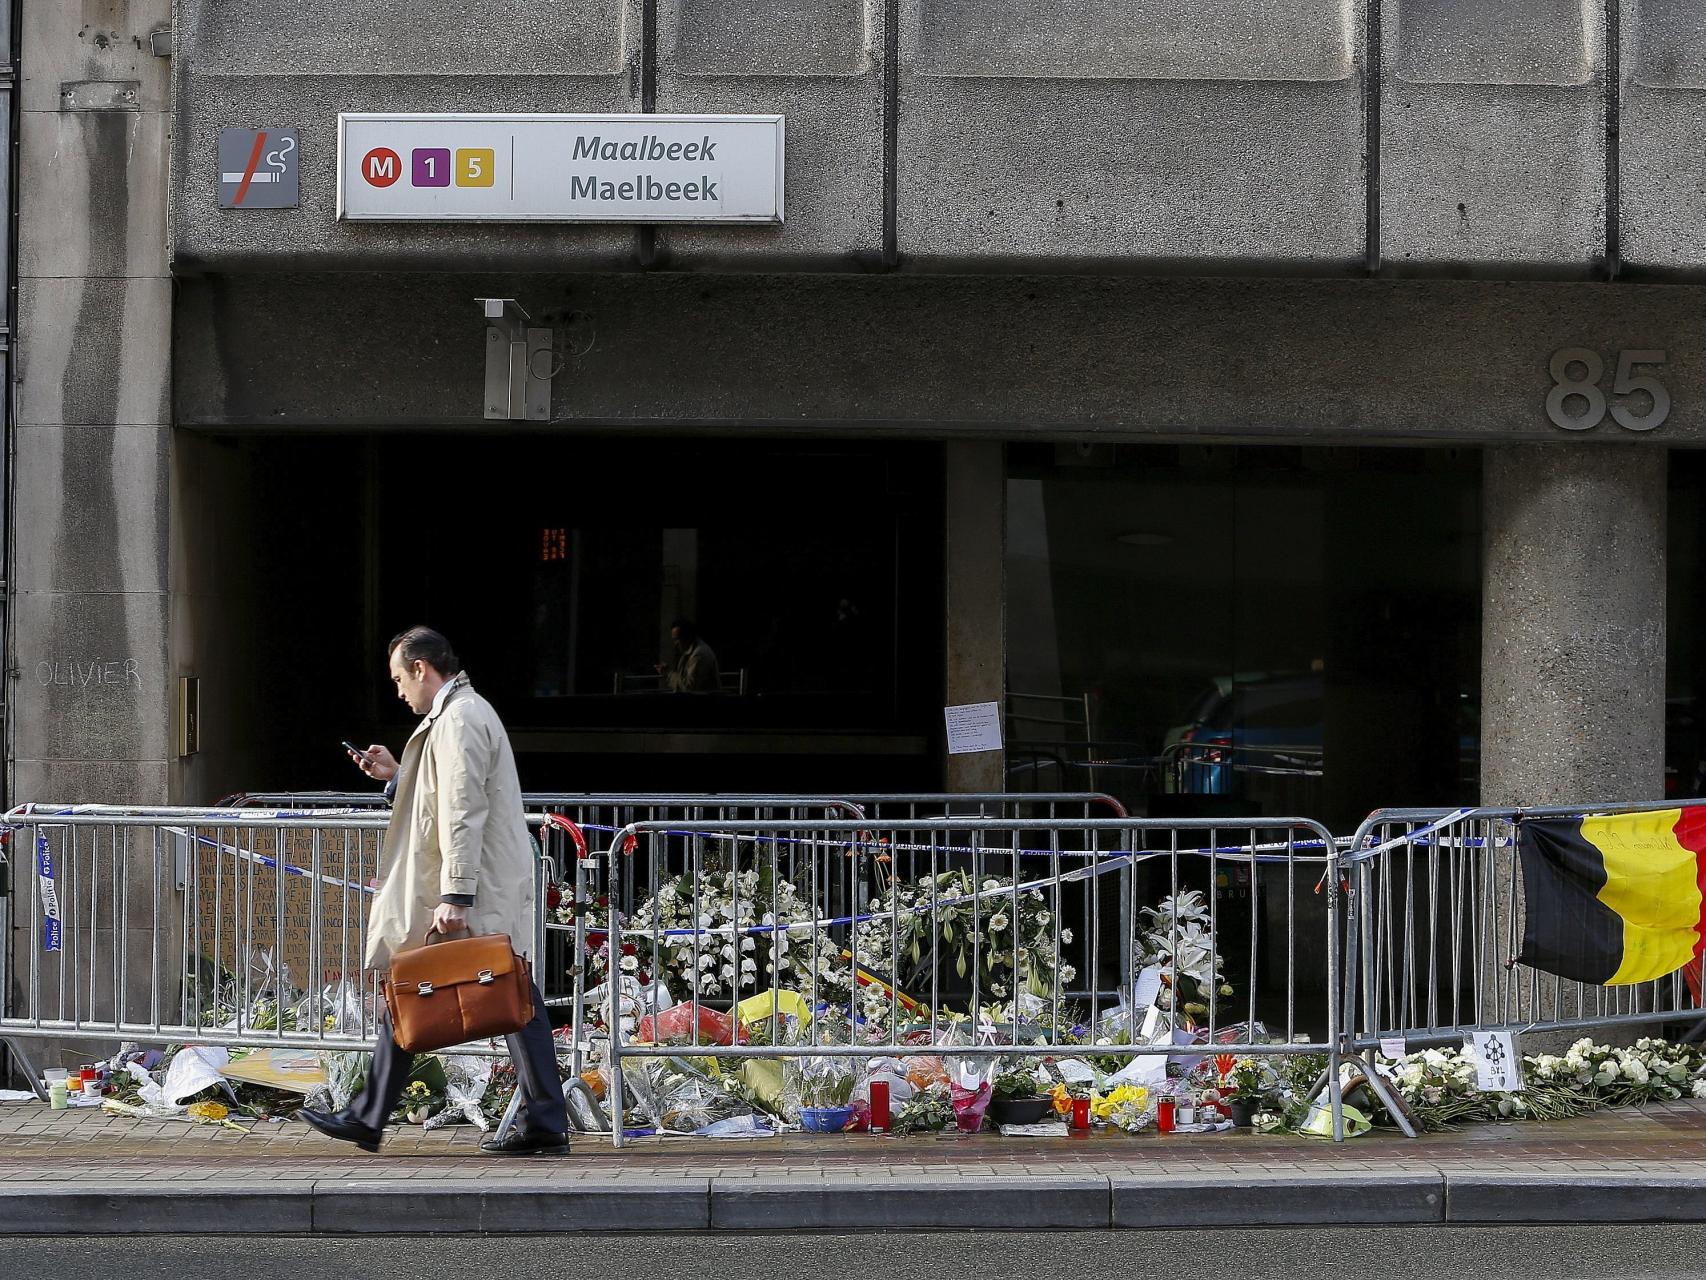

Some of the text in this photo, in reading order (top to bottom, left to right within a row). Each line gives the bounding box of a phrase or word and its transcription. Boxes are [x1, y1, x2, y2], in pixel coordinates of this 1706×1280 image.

[572, 136, 718, 161] Maalbeek
[370, 157, 481, 178] M 1 5
[571, 175, 718, 201] Maelbeek
[1546, 347, 1670, 430] 85
[43, 843, 51, 866] Police
[51, 921, 60, 946] Police
